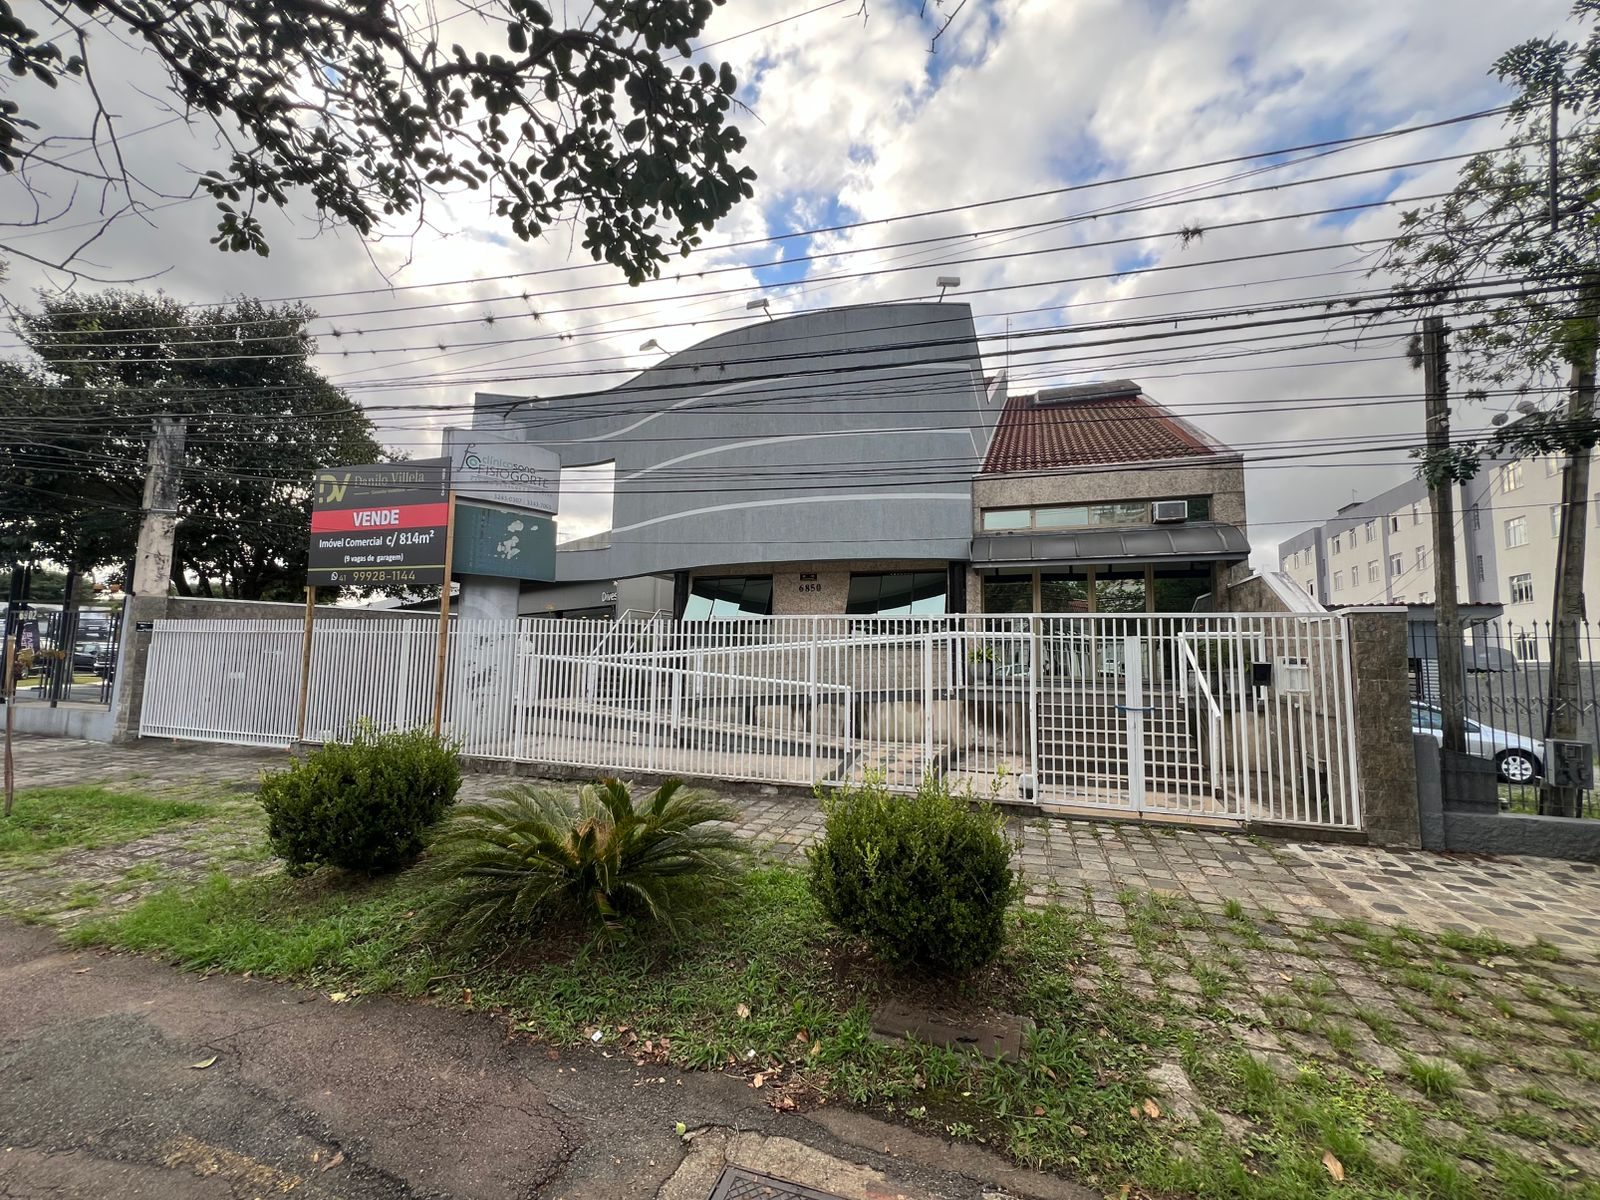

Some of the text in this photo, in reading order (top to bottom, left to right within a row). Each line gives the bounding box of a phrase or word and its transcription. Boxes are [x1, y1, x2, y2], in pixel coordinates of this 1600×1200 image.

[353, 509, 400, 527] VENDE
[319, 538, 344, 548] Imóvel
[345, 536, 383, 547] Comercial
[386, 531, 398, 547] c/
[351, 555, 366, 563] vagas
[367, 554, 374, 562] de
[376, 553, 404, 563] garagem)
[353, 571, 416, 581] 99928-1144
[799, 583, 821, 592] 6850
